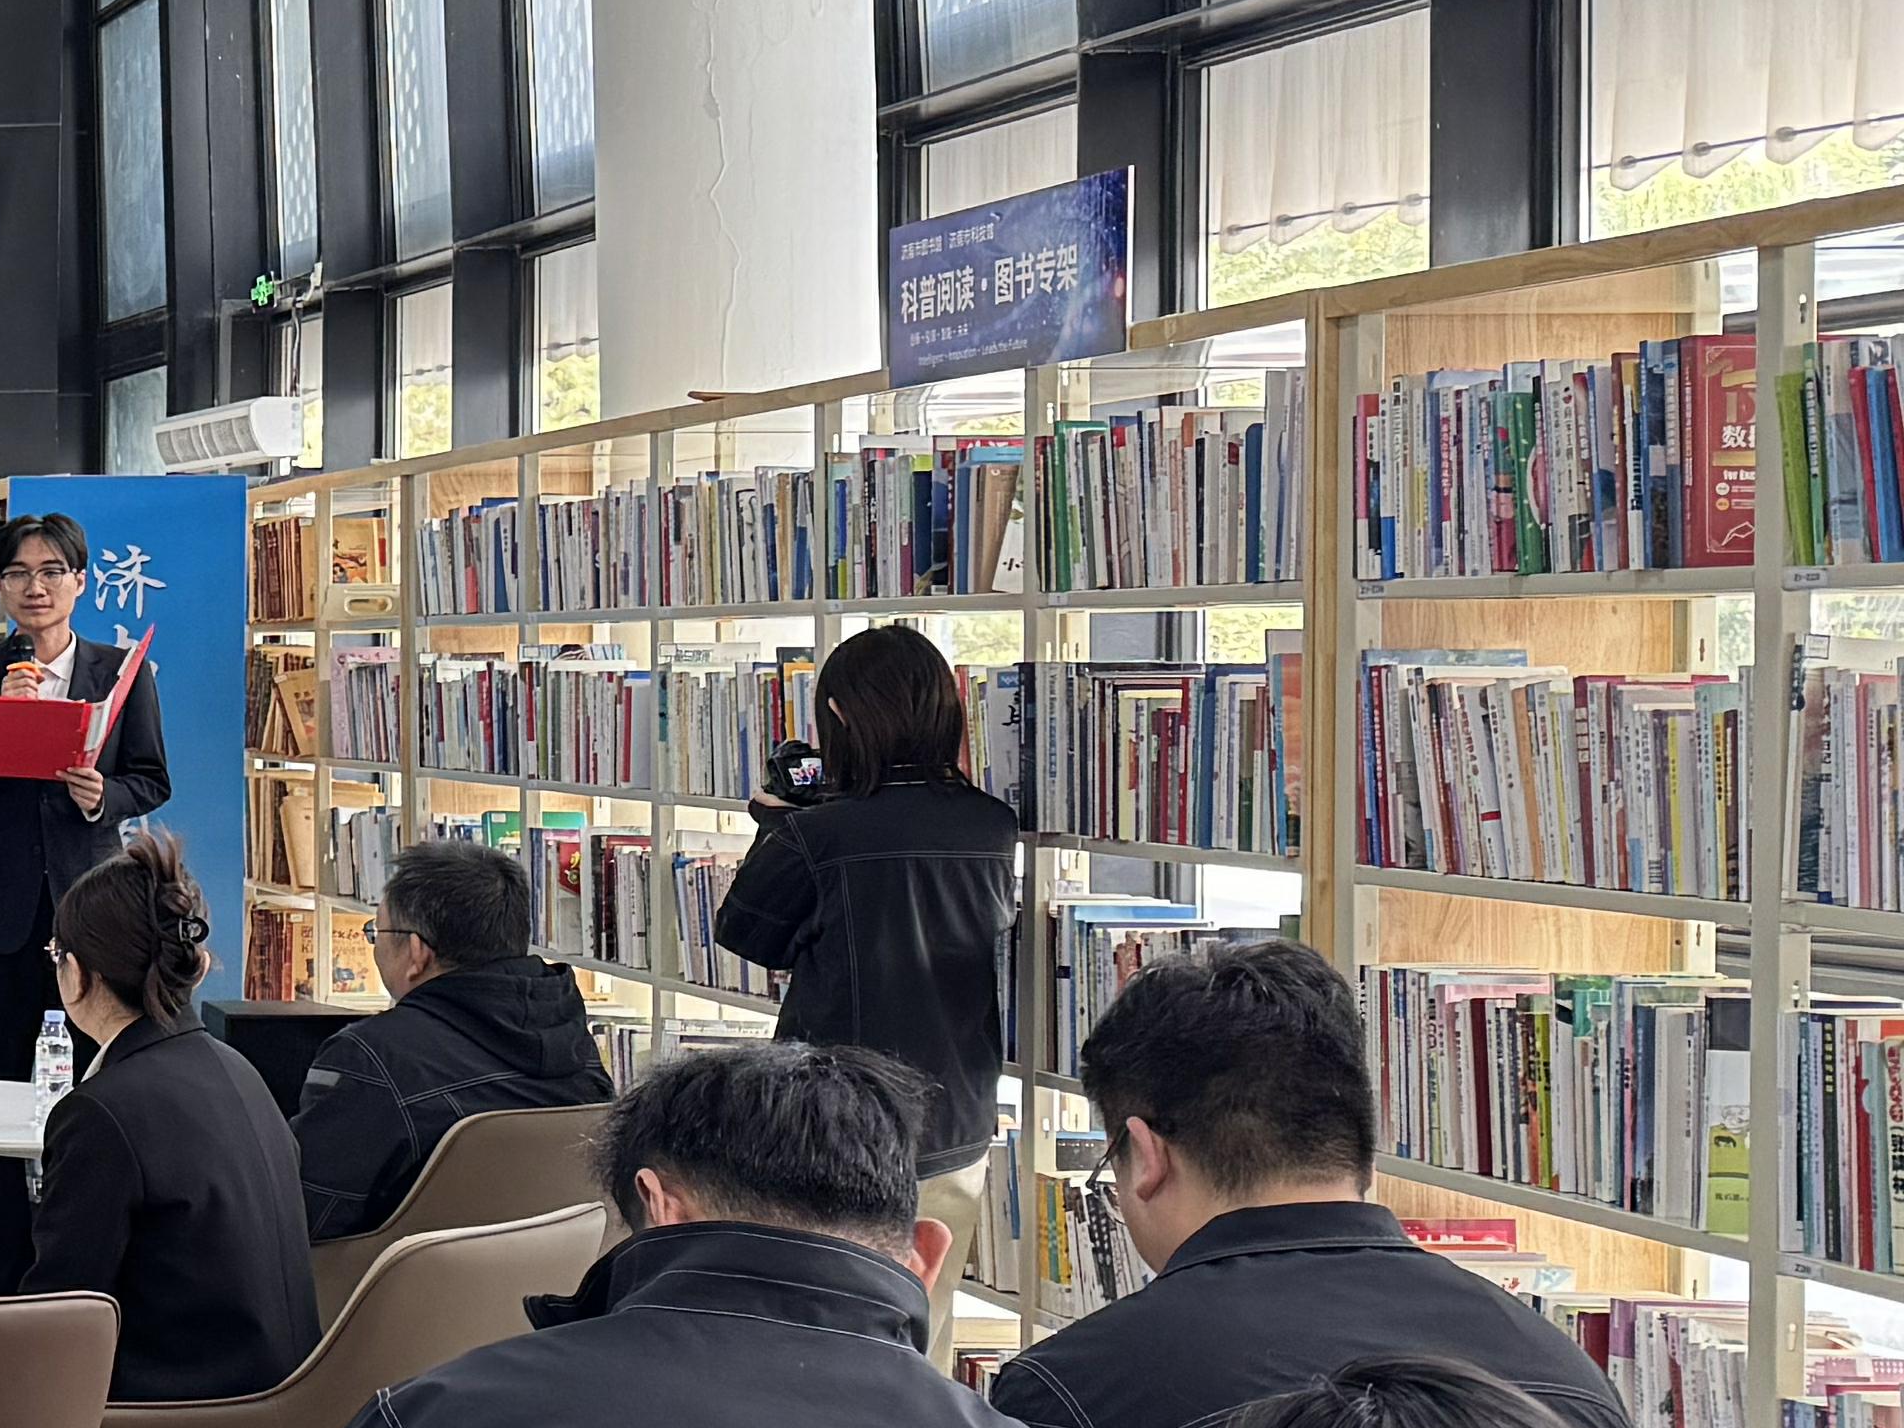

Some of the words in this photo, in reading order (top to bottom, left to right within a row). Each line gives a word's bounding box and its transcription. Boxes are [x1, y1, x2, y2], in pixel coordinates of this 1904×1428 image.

[900, 243, 1078, 324] 科普阅读·图书专架
